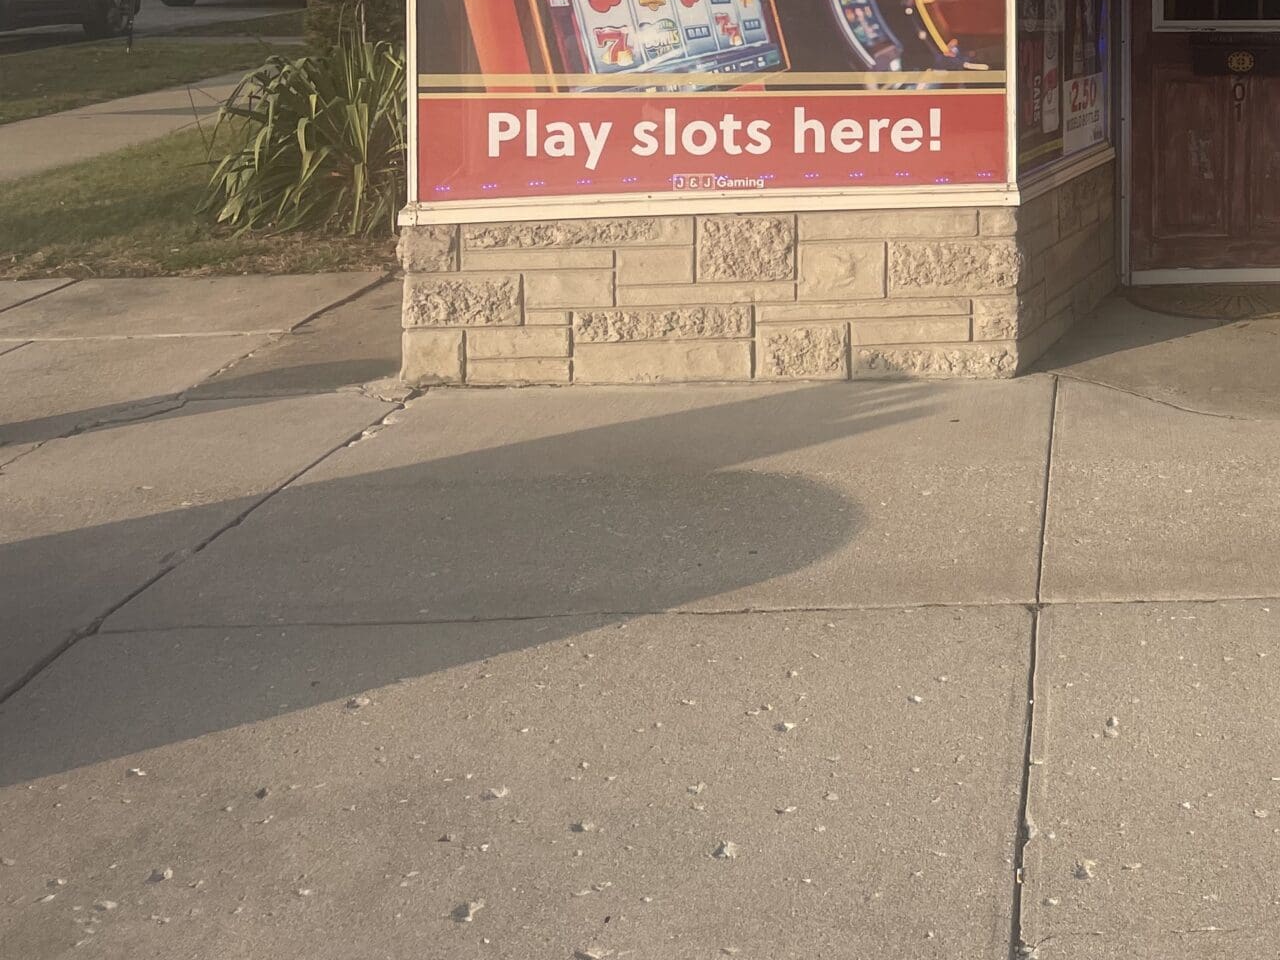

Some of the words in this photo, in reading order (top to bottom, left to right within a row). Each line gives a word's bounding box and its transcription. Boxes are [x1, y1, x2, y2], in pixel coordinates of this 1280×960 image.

[687, 27, 709, 38] BAR
[488, 109, 612, 170] Play
[631, 108, 772, 156] slots
[794, 106, 942, 154] here!
[716, 176, 764, 188] Gaming
